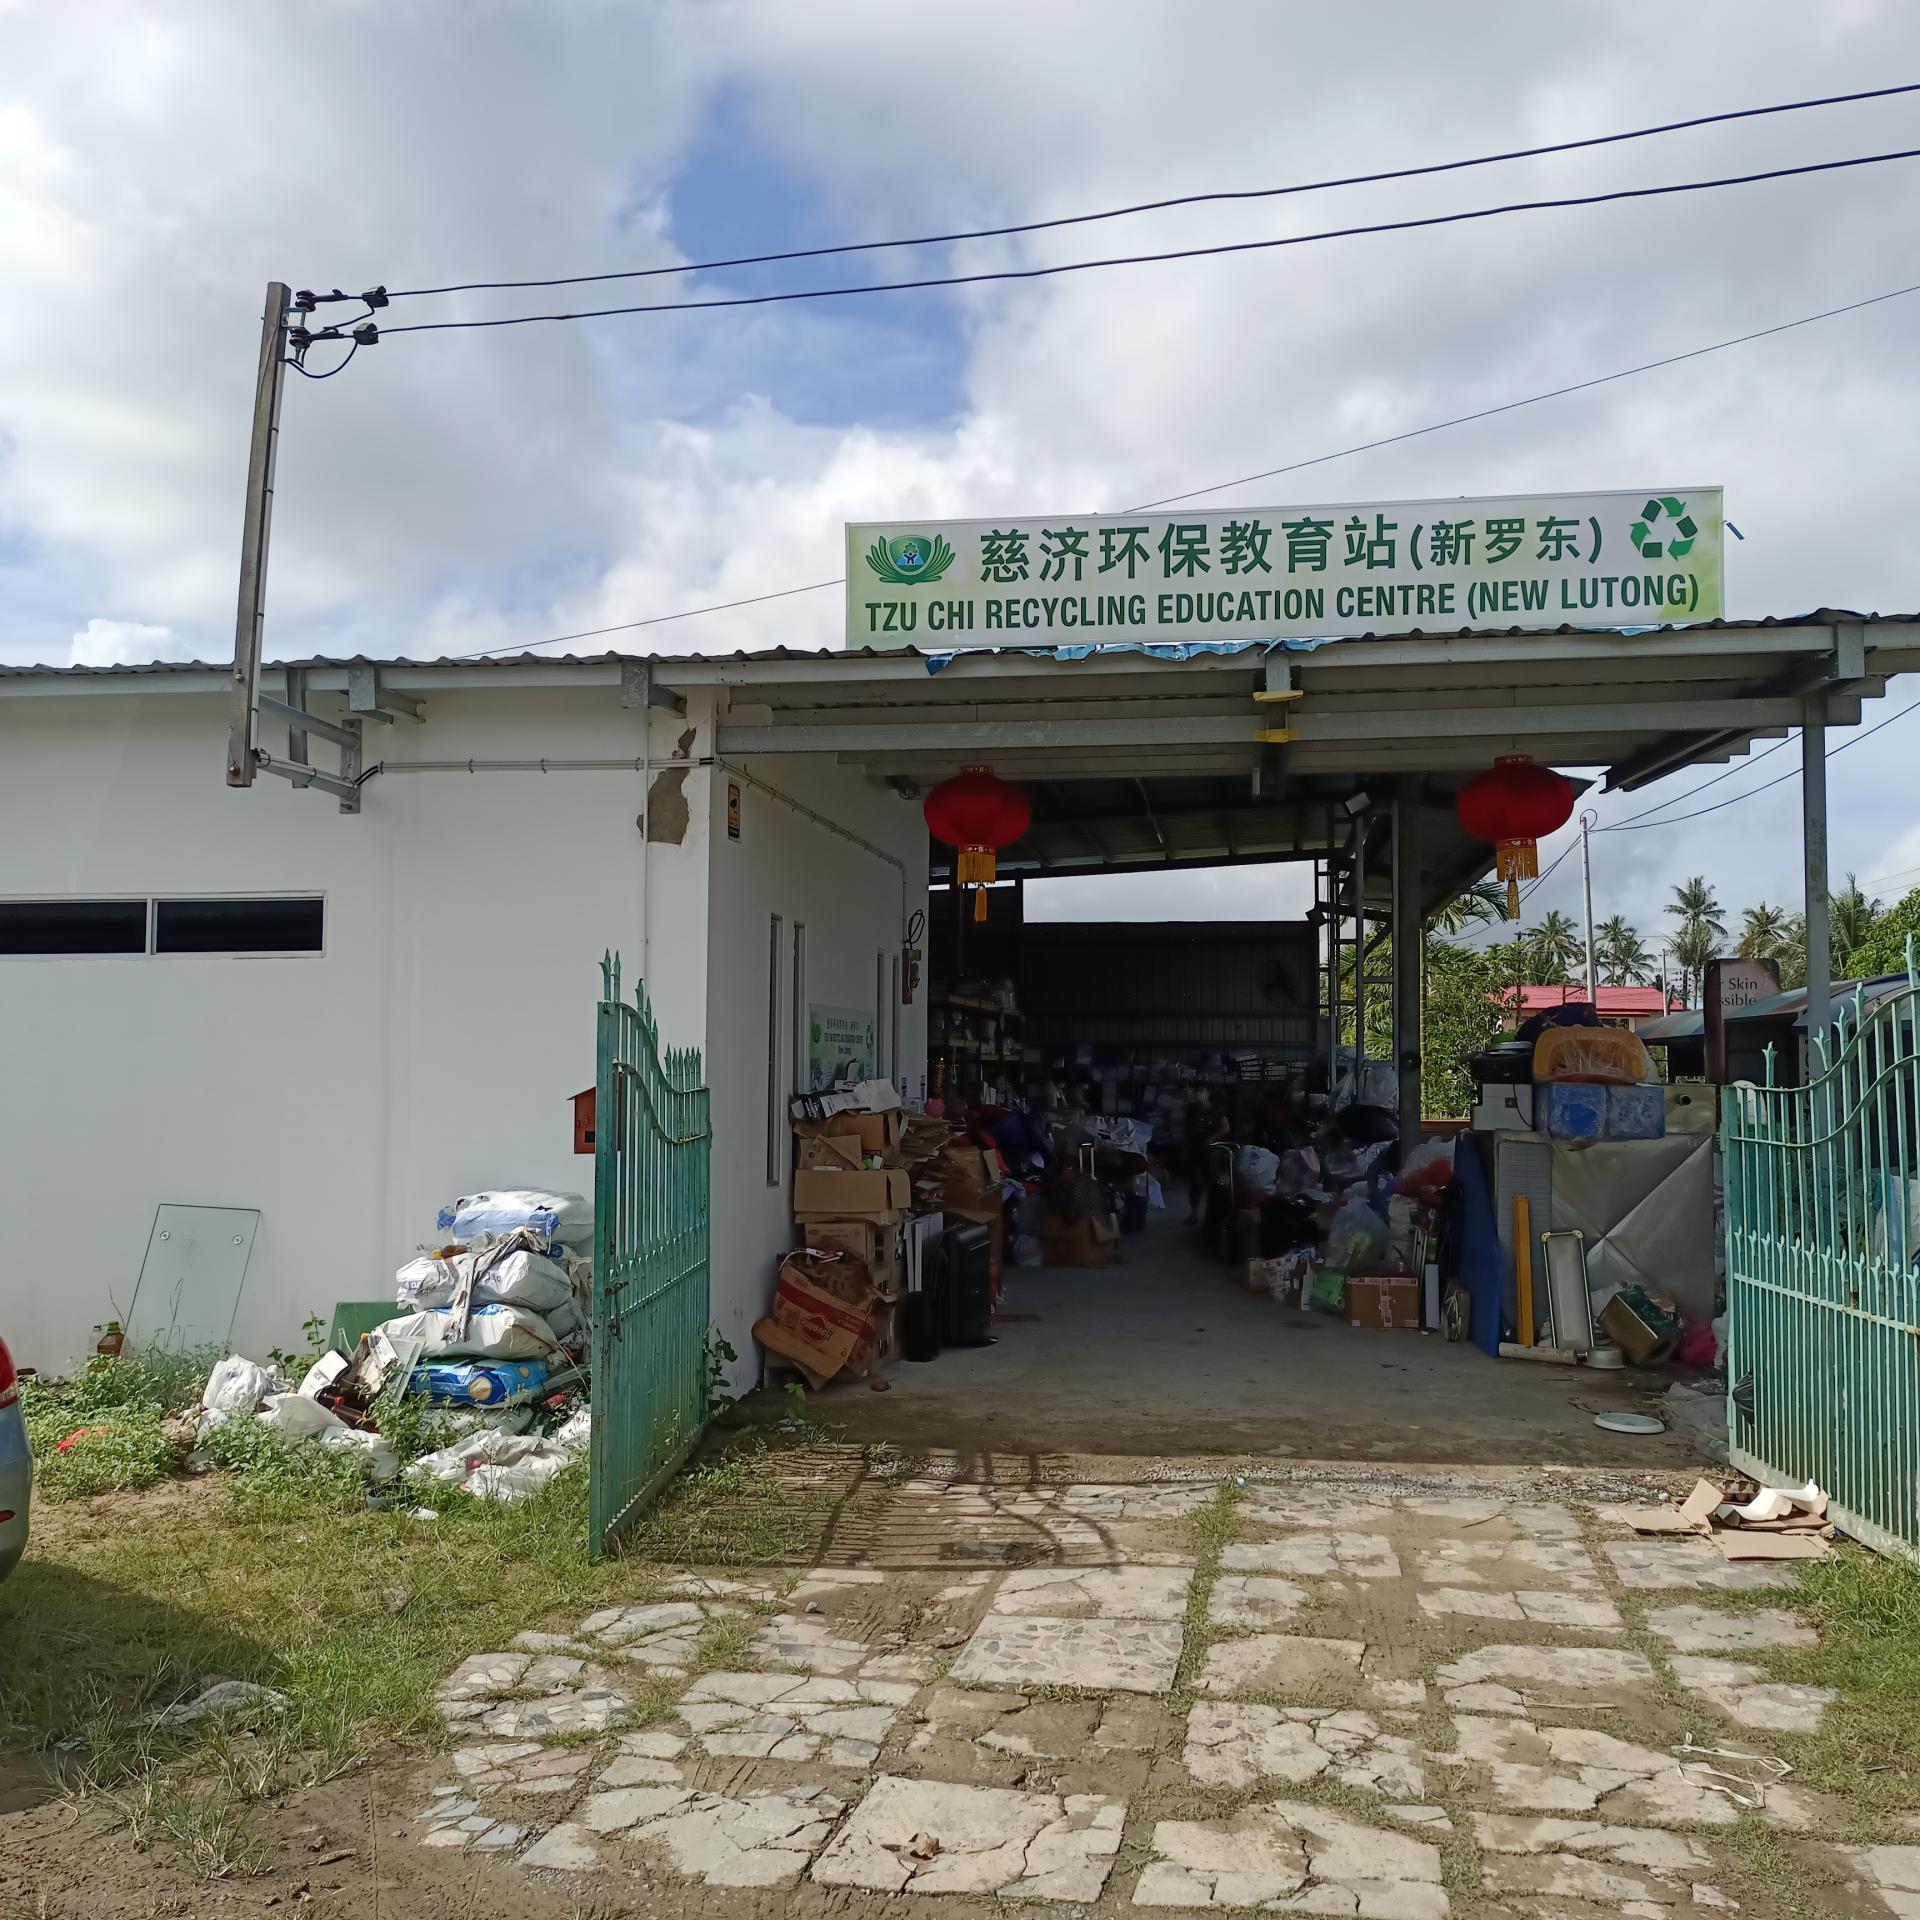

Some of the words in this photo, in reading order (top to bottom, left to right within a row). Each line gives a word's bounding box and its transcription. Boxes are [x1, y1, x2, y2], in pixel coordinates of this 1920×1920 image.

[864, 601, 917, 632] TZU
[927, 600, 974, 631] CHI
[985, 594, 1146, 629] RECYCLING
[1157, 586, 1324, 624] EDUCATION
[1336, 583, 1455, 618] CENTRE
[1467, 579, 1550, 621] (NEW
[1561, 573, 1699, 613] LUTONG)
[1728, 977, 1758, 990] Skin
